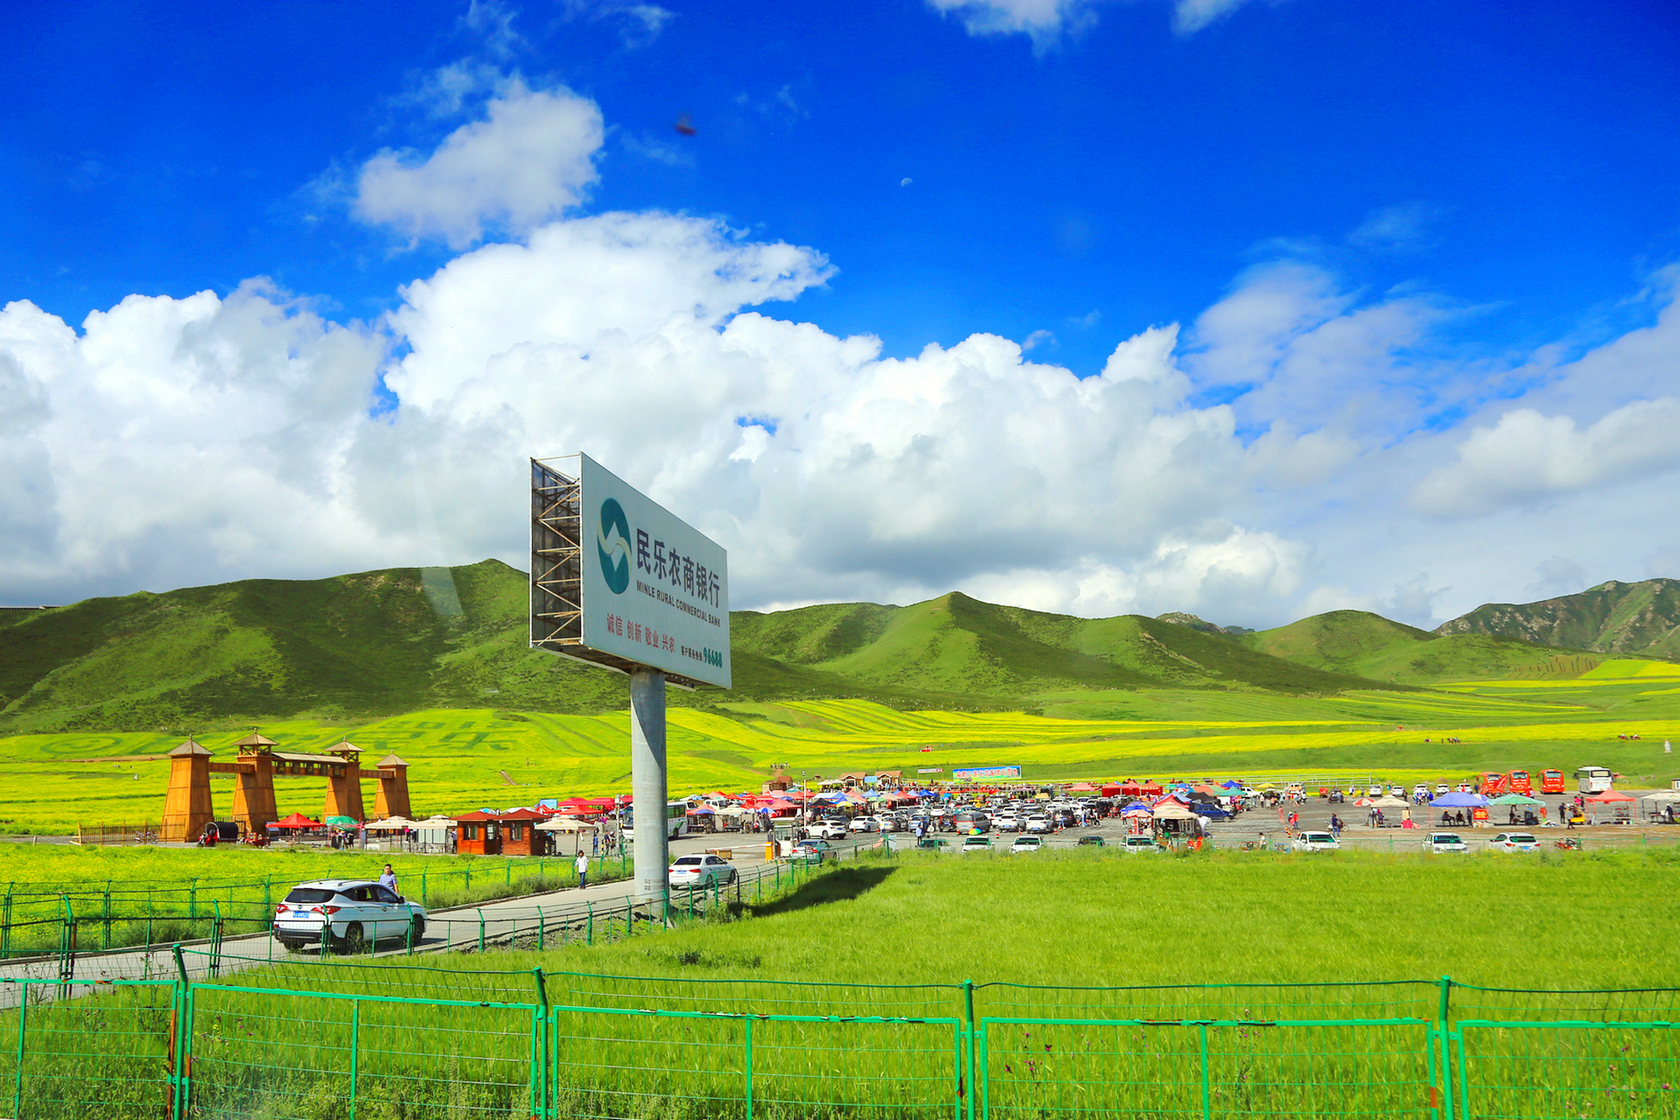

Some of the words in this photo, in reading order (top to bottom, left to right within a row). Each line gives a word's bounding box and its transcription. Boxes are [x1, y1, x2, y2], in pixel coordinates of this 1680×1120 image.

[637, 528, 720, 608] 民乐农商银行
[637, 580, 655, 598] MINLE
[657, 589, 675, 607] RURAL
[676, 599, 708, 622] COMMERCIAL
[708, 613, 721, 628] BANK
[607, 613, 622, 637] 诚信
[627, 620, 642, 643] 创新
[645, 626, 659, 648] 敬业
[662, 634, 675, 653] 兴农
[703, 647, 722, 668] 96688
